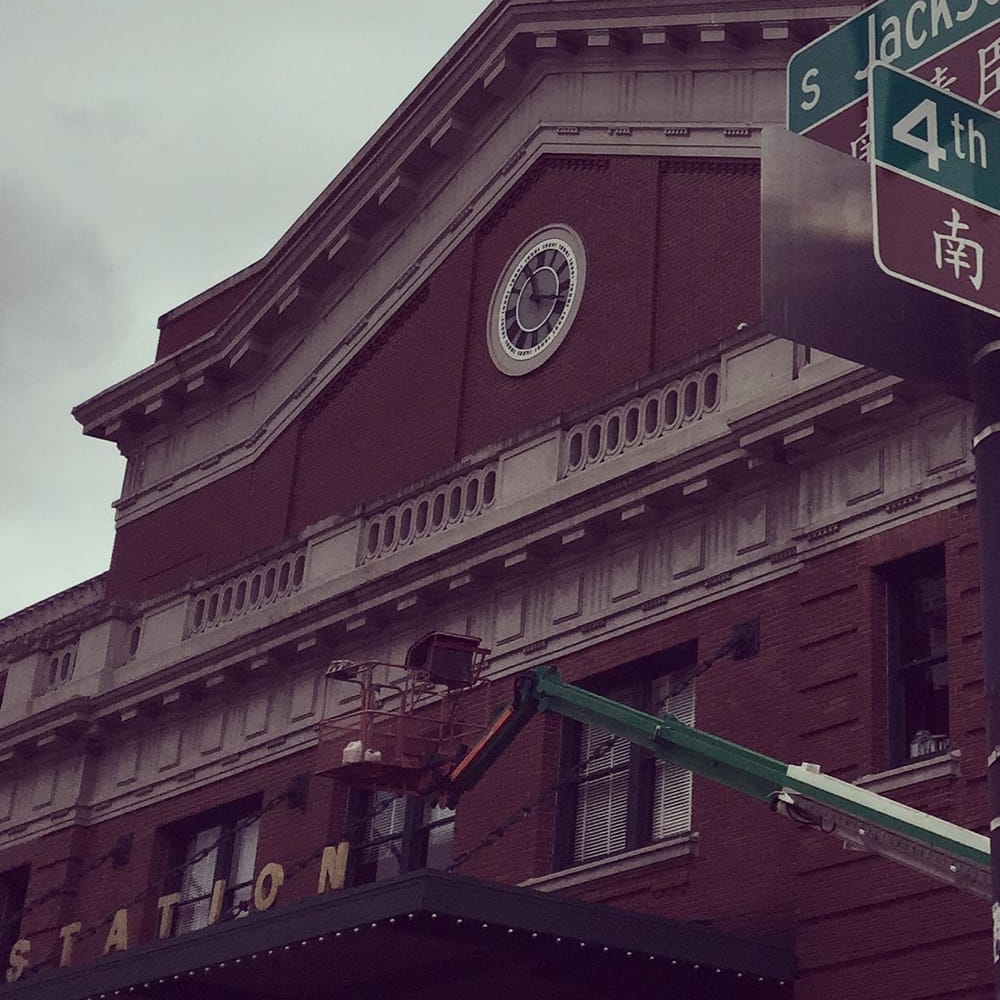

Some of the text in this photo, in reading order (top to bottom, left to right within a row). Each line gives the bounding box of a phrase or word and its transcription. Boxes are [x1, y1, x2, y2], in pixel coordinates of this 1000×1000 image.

[800, 67, 821, 111] S
[892, 98, 988, 171] 4th
[6, 841, 350, 984] STATION
